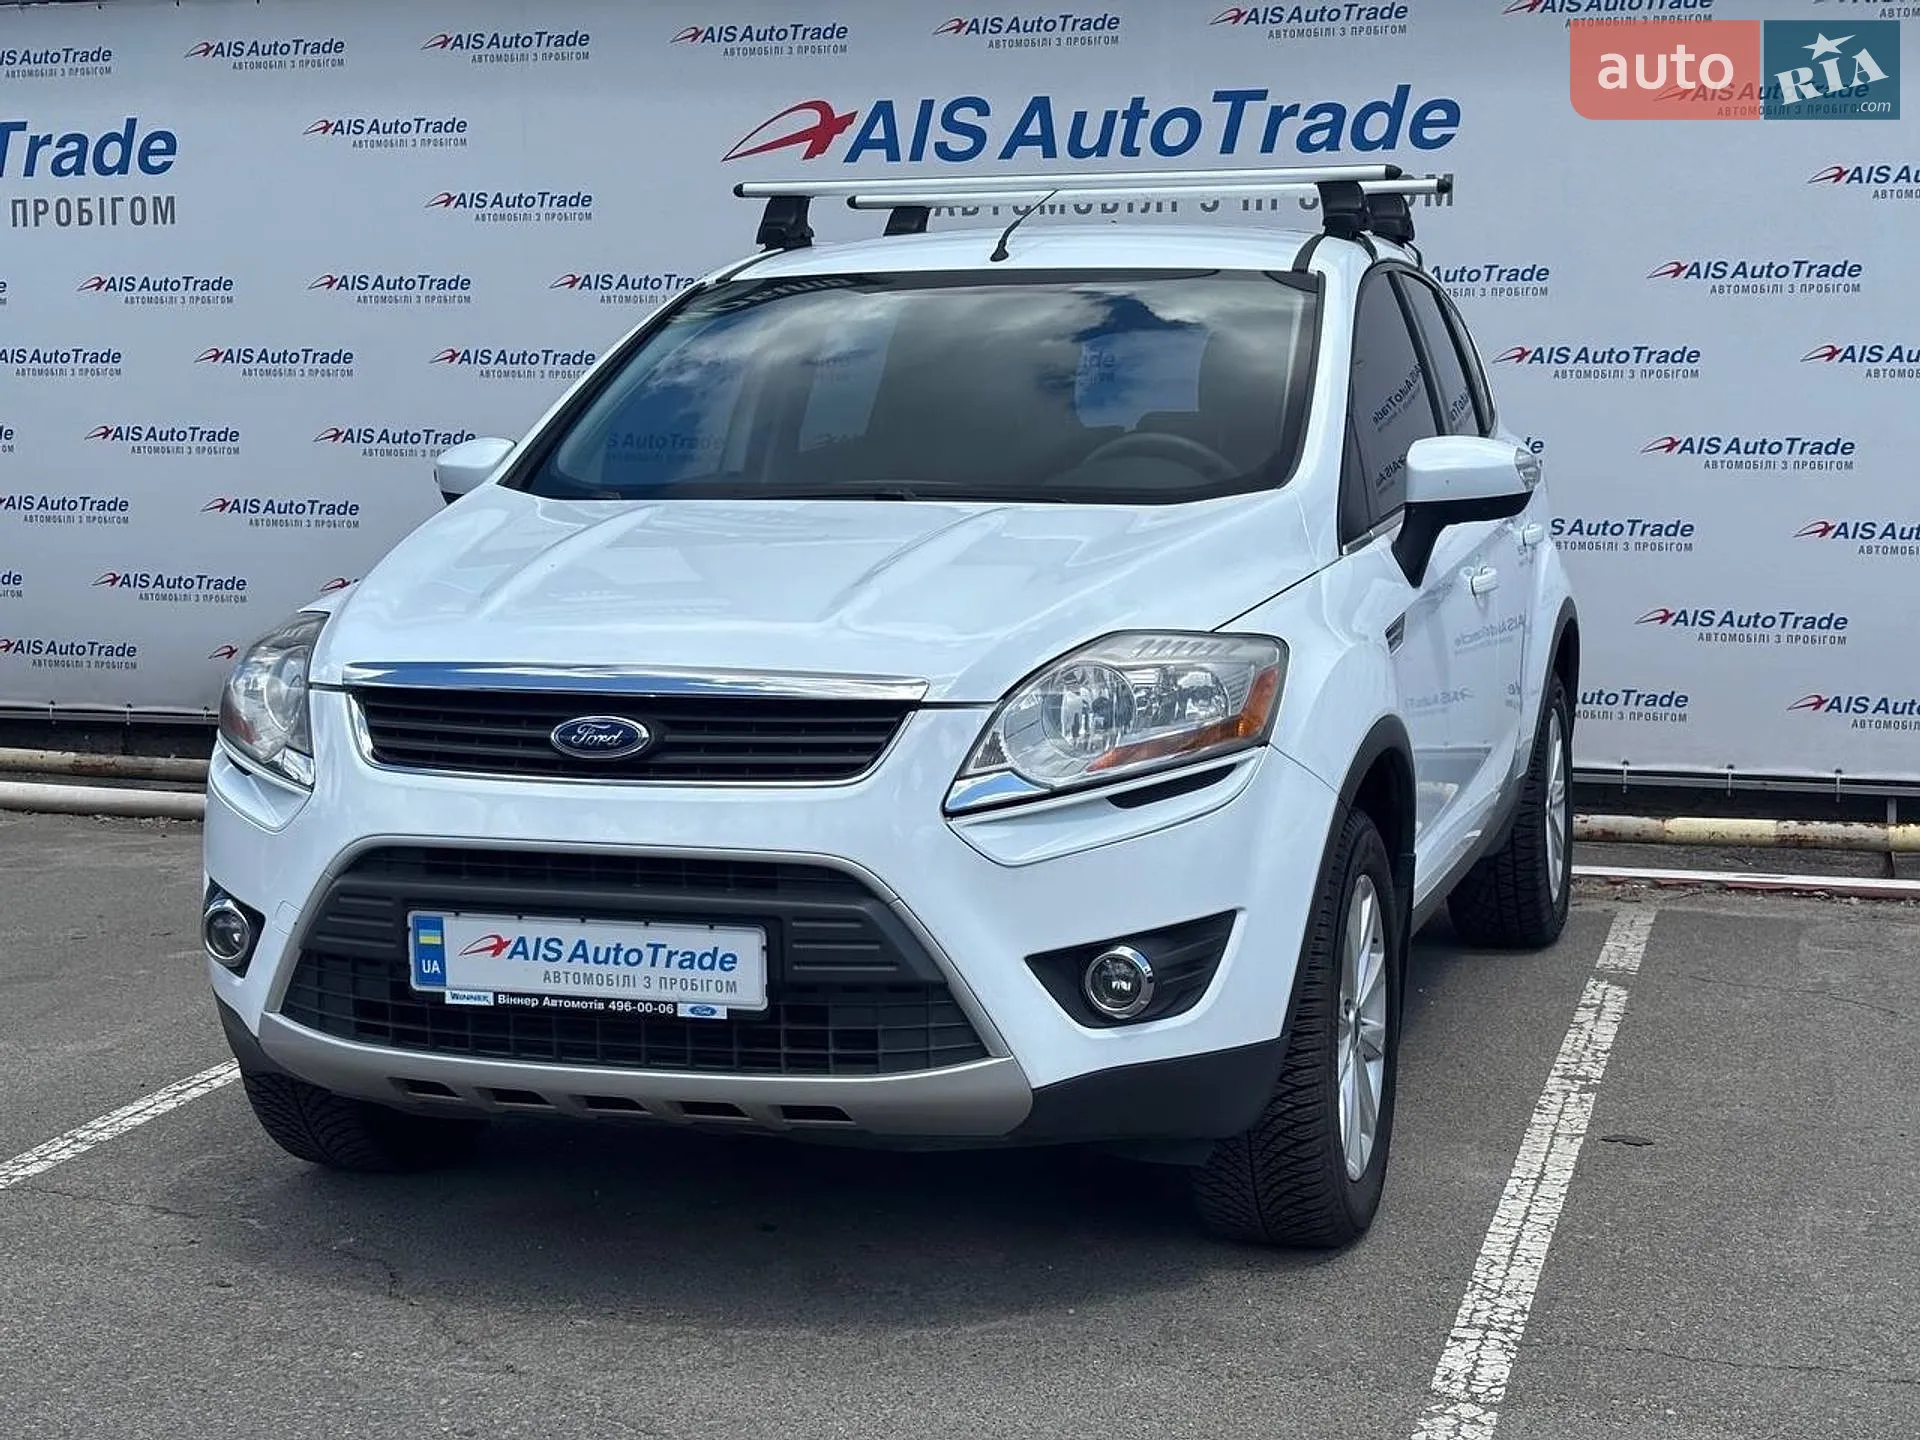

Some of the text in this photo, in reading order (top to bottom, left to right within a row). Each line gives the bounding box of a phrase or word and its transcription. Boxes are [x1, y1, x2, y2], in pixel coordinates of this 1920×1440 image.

[12, 196, 176, 227] ПРОБІГОМ
[572, 723, 623, 745] Ford
[422, 959, 441, 974] UA
[543, 970, 737, 993] АВТОМОБІЛІ З ПРОБІГОМ
[608, 1000, 674, 1014] 496-00-06
